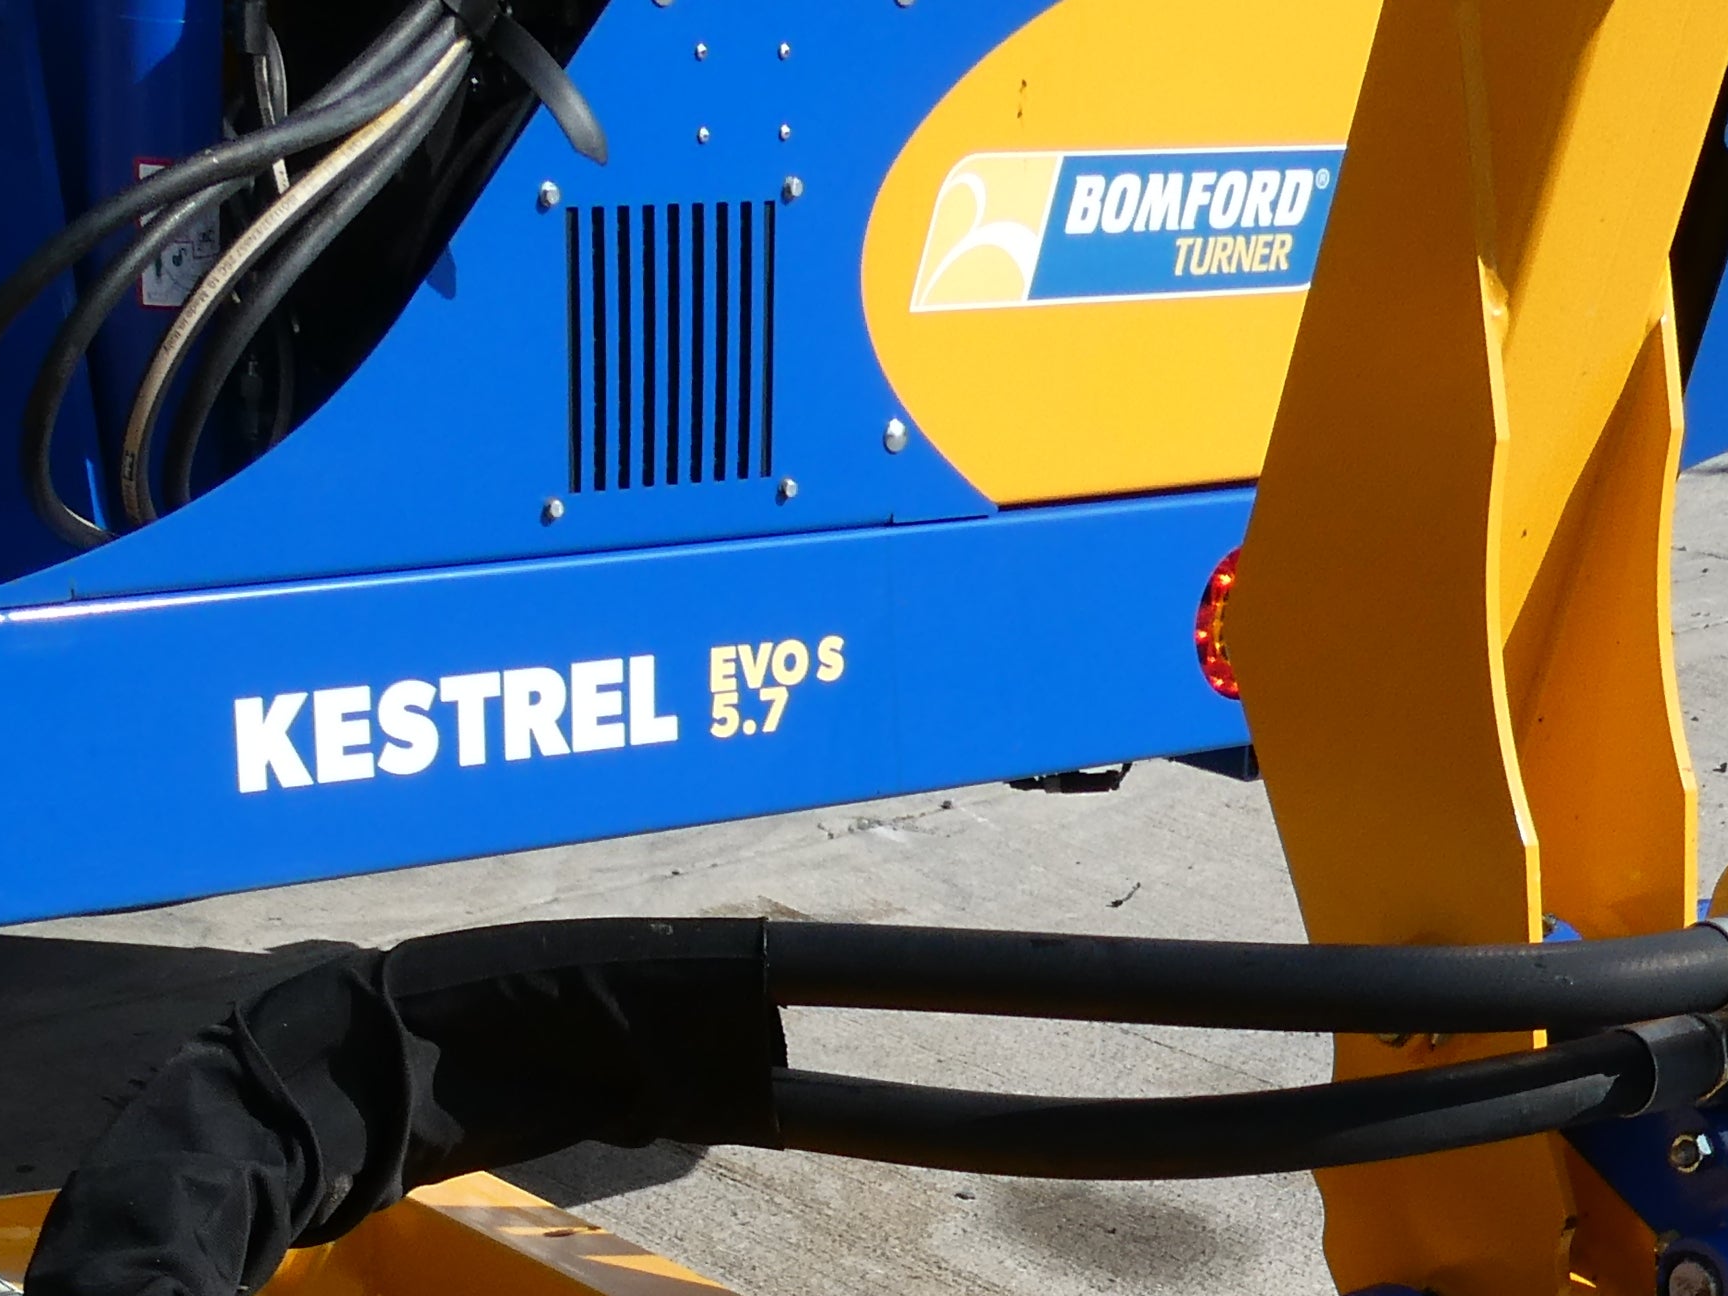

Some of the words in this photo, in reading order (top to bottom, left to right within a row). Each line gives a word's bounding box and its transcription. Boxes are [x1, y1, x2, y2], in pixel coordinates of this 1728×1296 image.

[1173, 233, 1293, 276] TURNER
[183, 288, 210, 319] Made
[162, 330, 183, 355] Italy
[234, 654, 678, 794] KESTREL
[710, 641, 809, 693] EVO
[817, 635, 846, 683] S
[710, 688, 790, 739] 5.7
